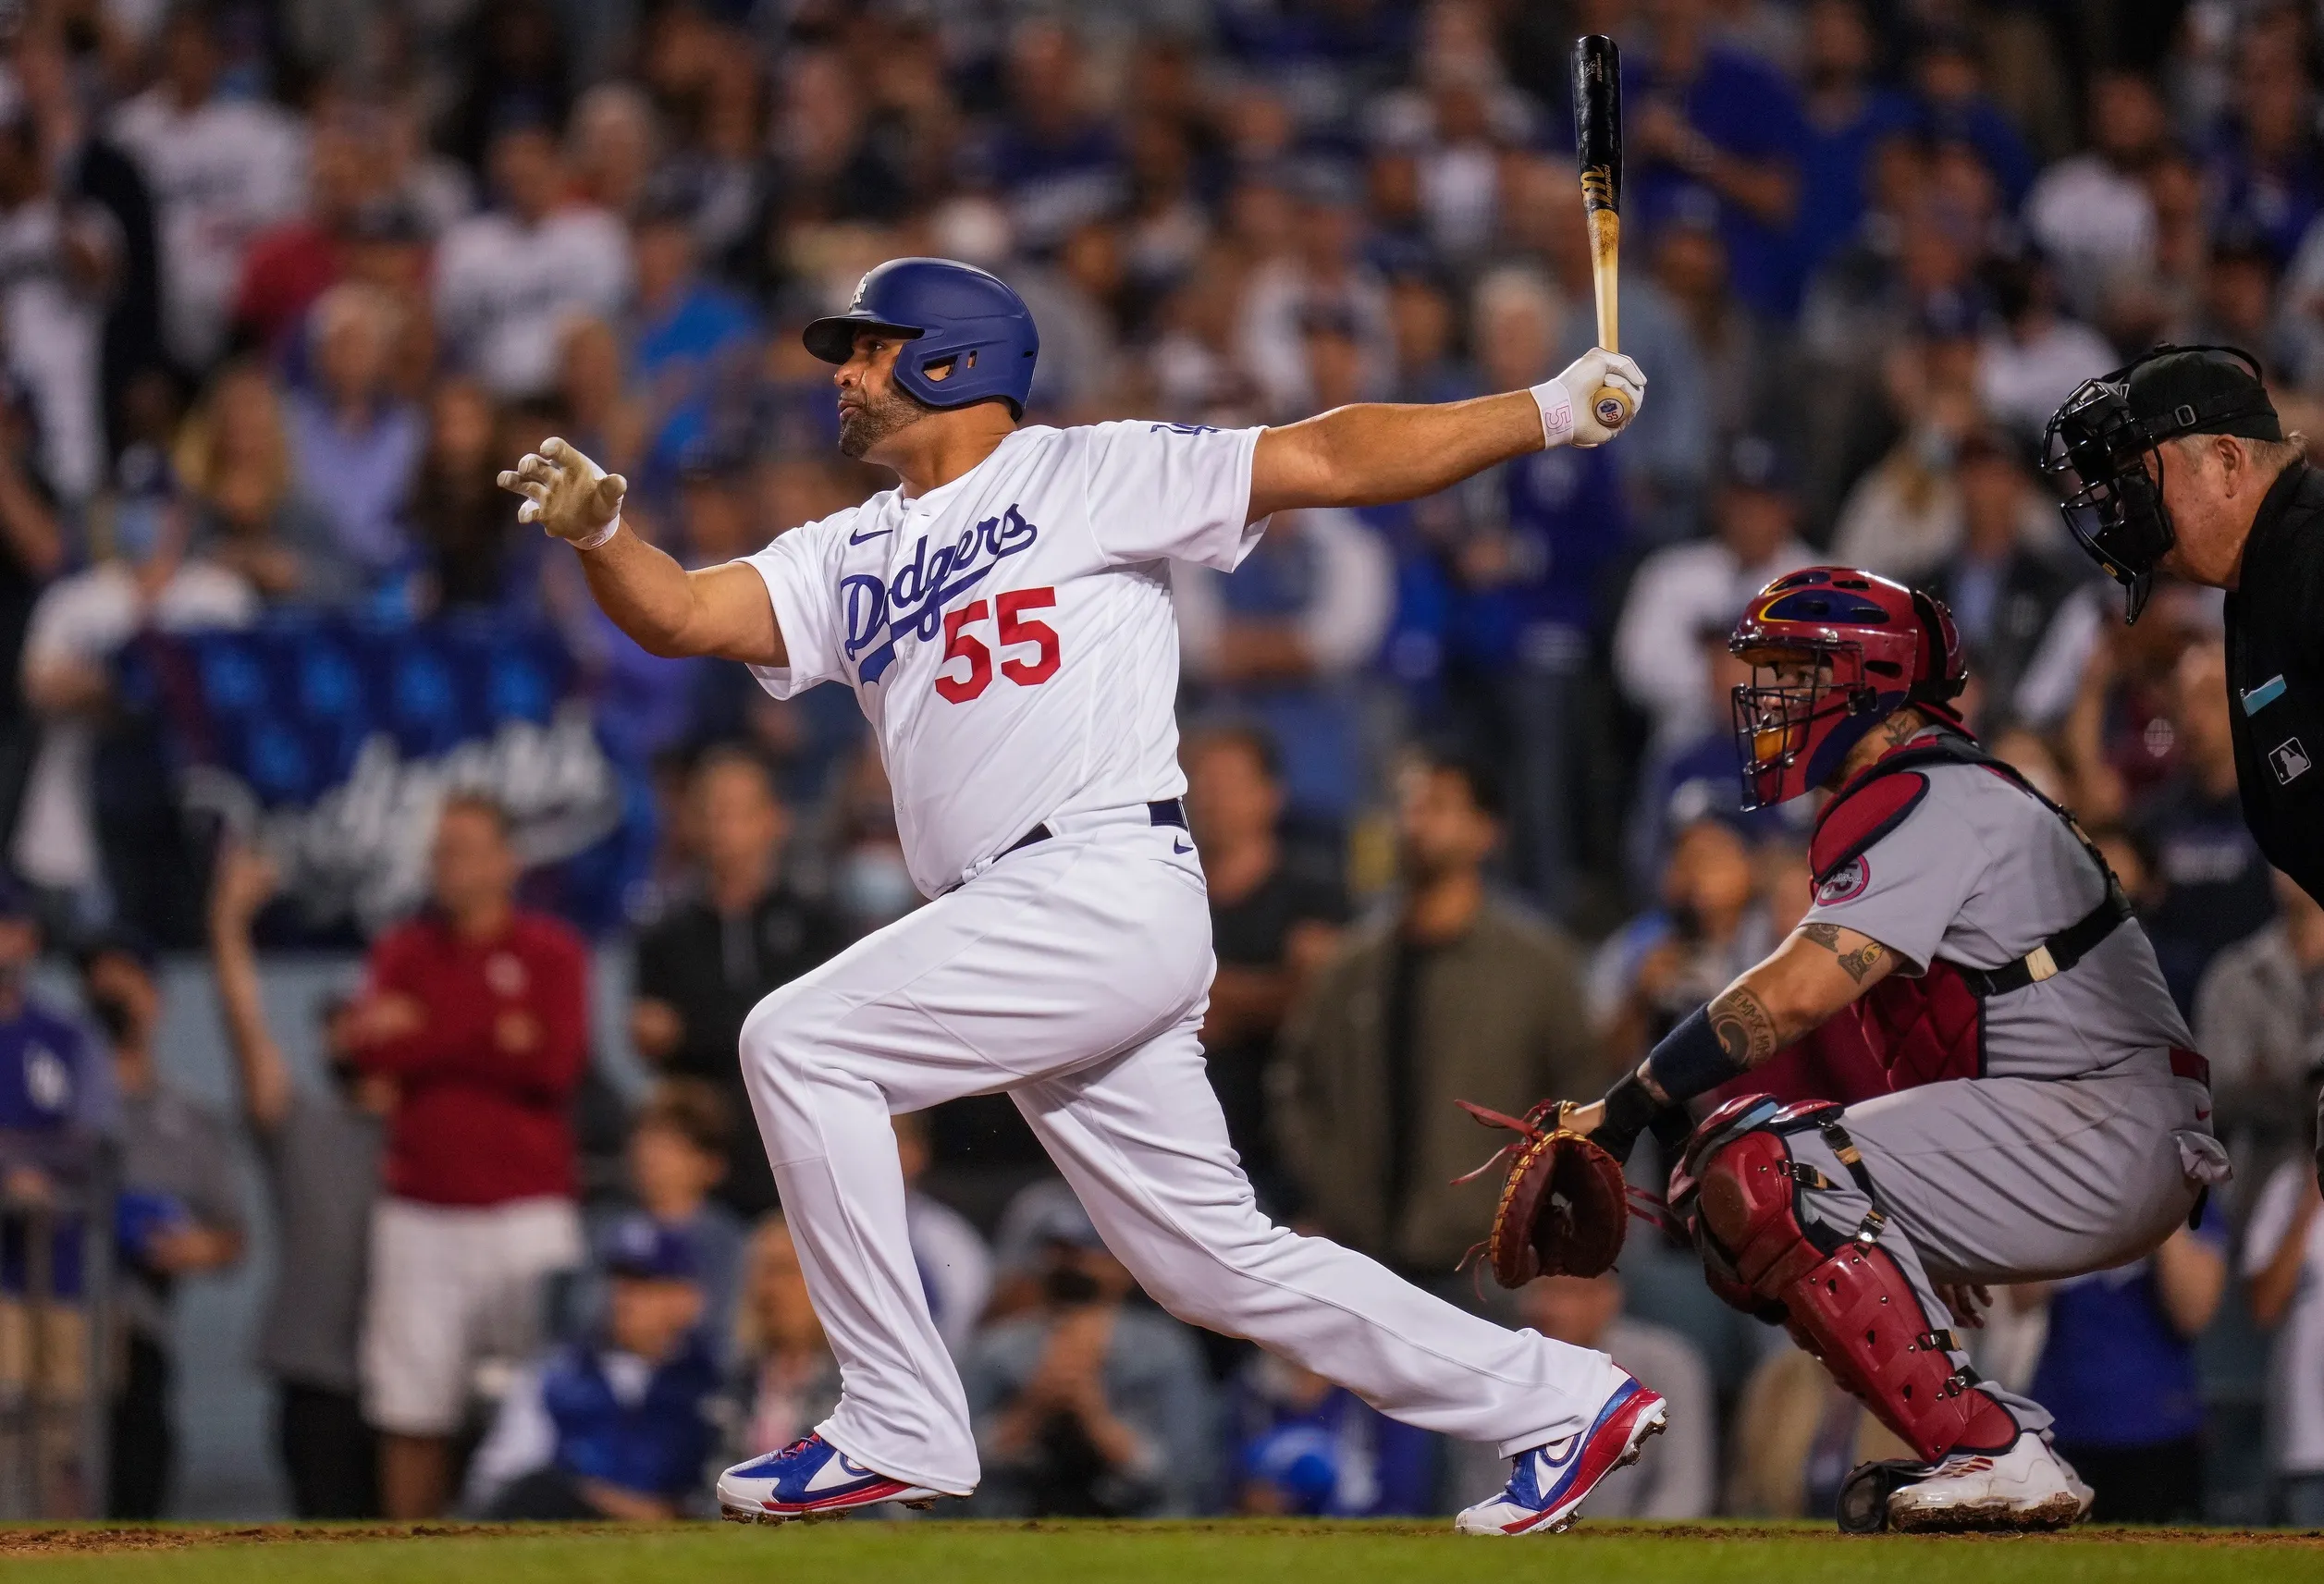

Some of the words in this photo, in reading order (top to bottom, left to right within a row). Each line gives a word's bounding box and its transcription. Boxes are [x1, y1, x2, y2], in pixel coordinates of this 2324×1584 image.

[1605, 411, 1618, 422] 55
[840, 503, 1038, 663] Dodgers
[935, 586, 1062, 705] 55
